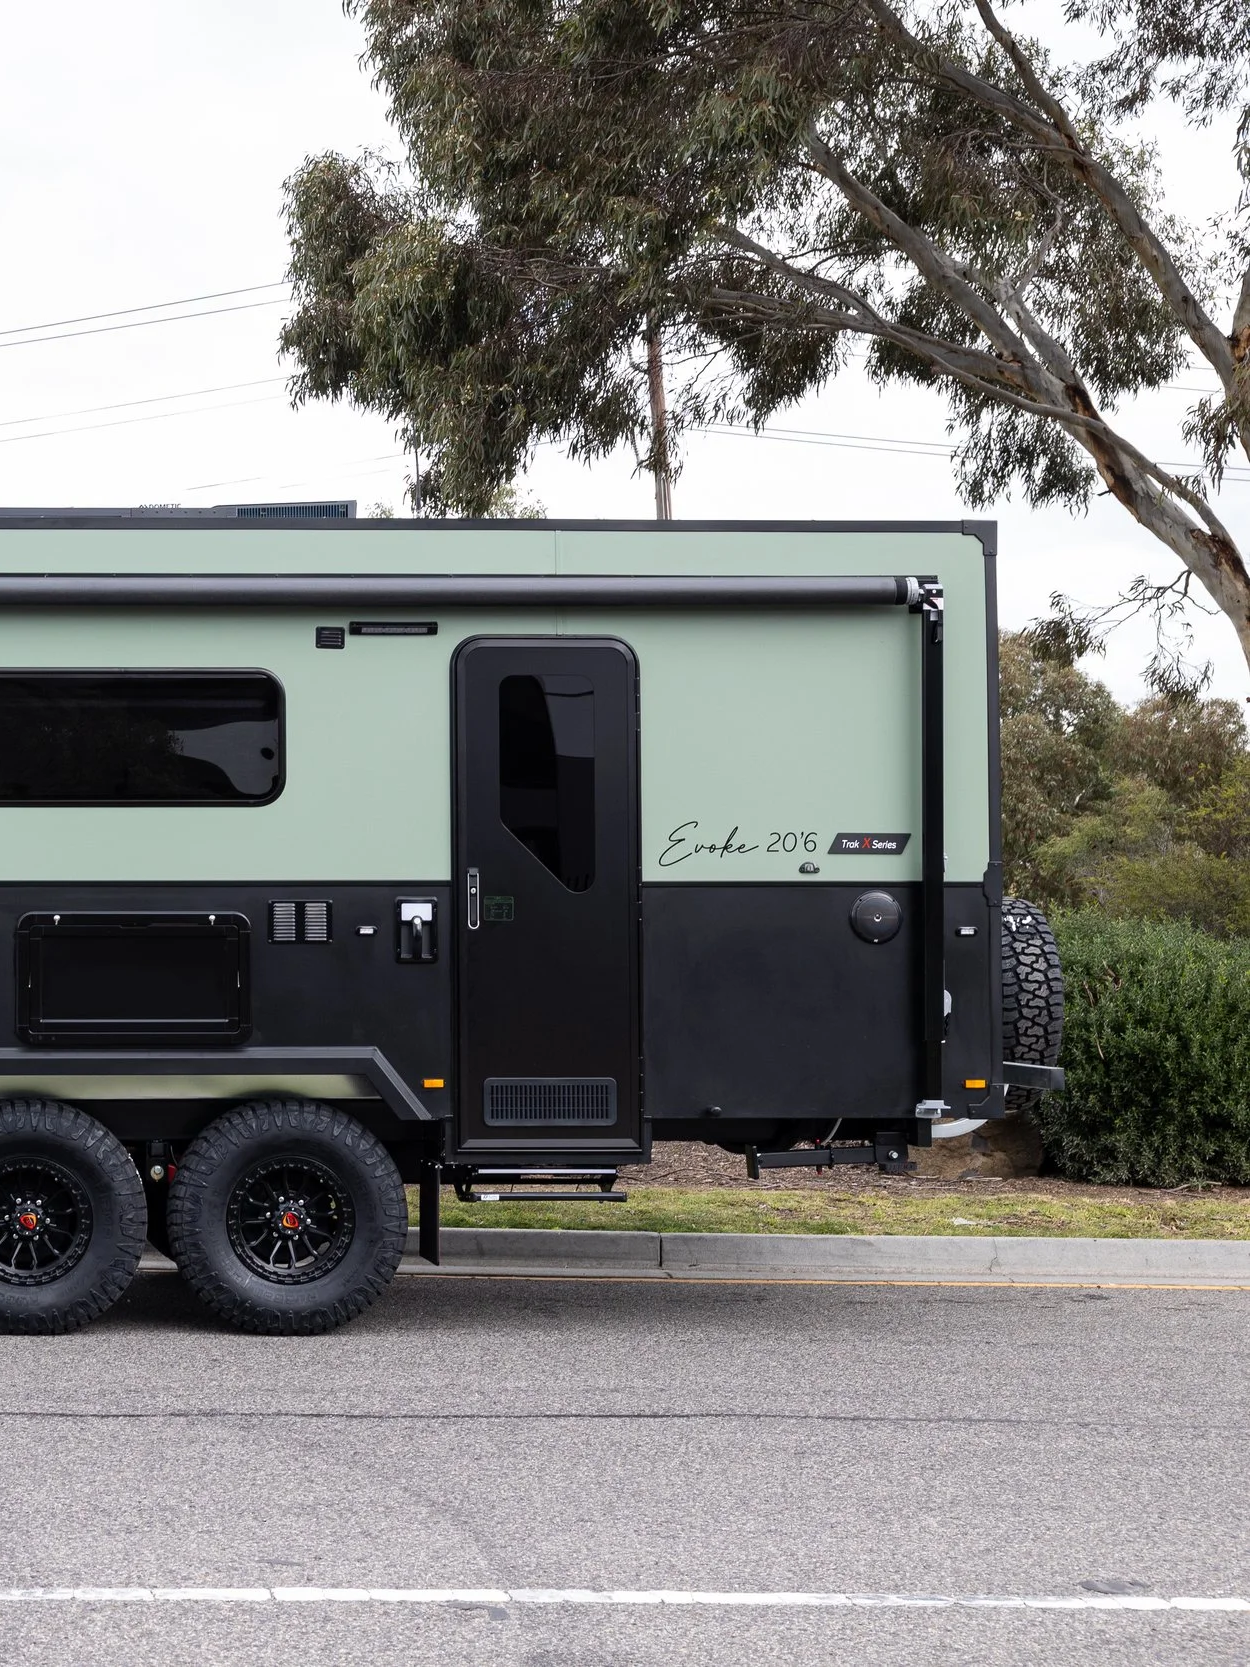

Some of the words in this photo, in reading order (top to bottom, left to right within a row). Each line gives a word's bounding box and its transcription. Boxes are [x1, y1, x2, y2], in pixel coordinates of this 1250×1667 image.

[658, 820, 759, 866] Evoke
[766, 832, 817, 853] 20'6
[841, 839, 860, 849] Trak
[862, 837, 871, 849] X
[871, 839, 897, 849] Series
